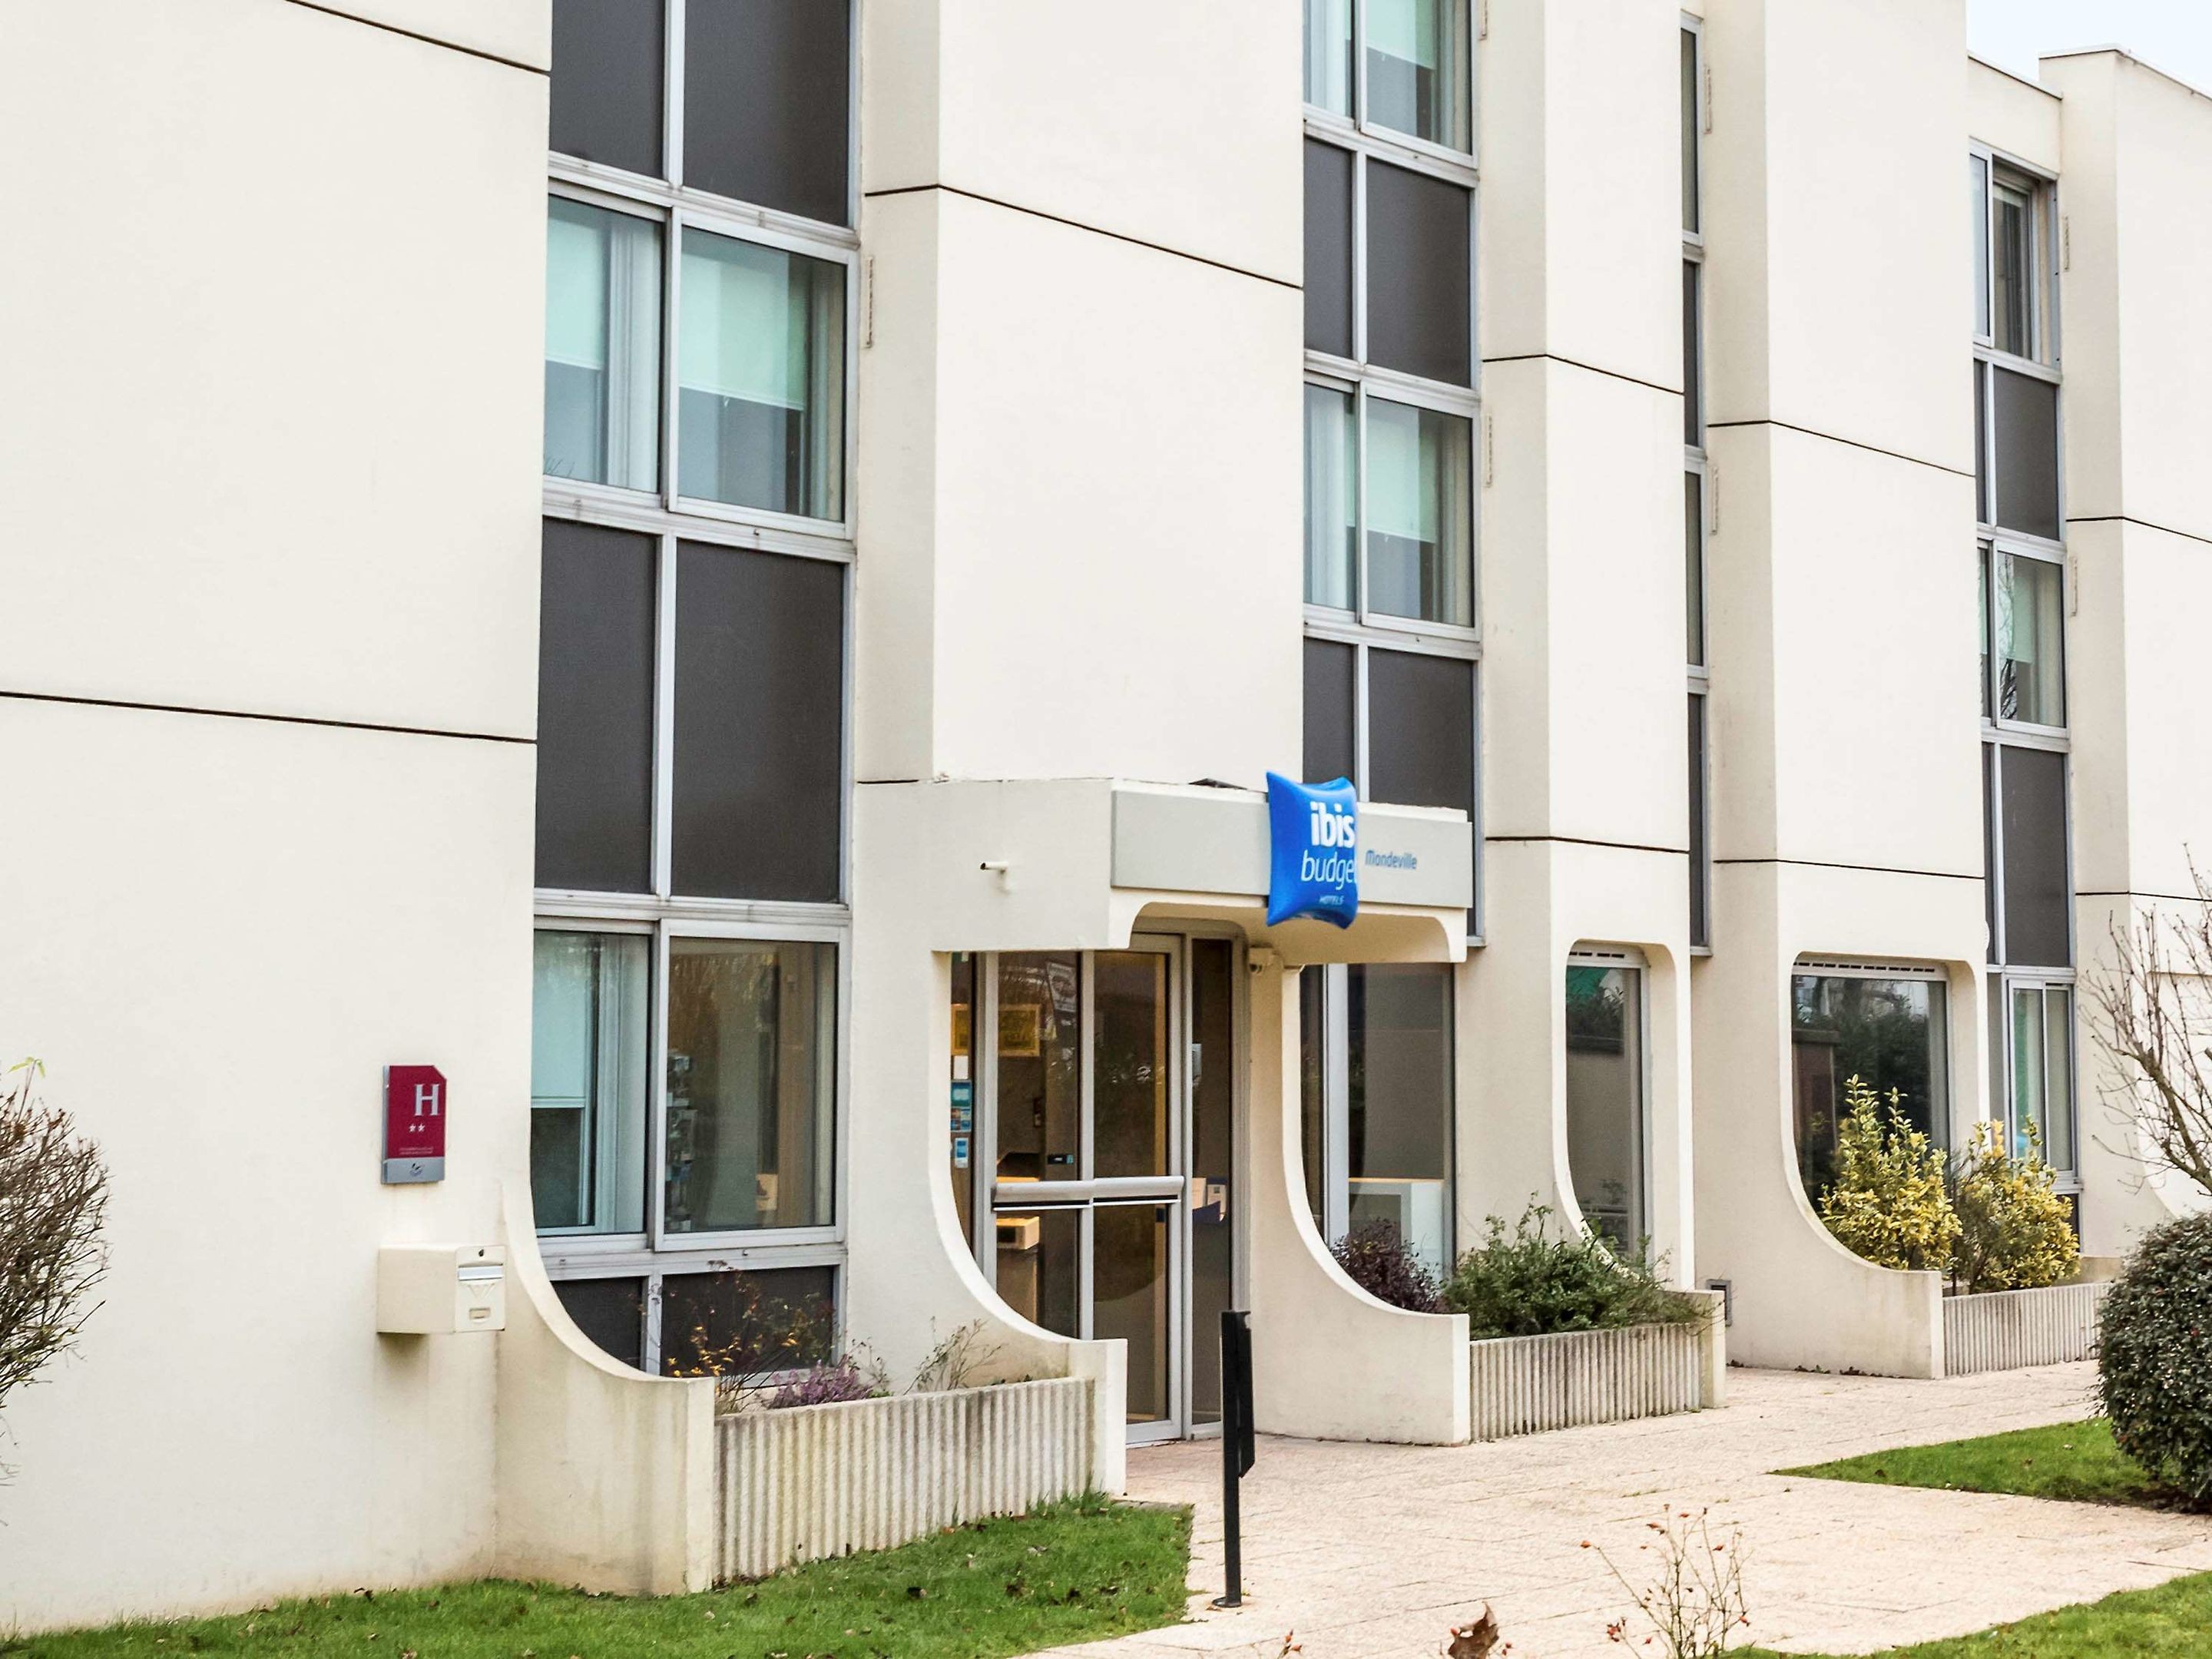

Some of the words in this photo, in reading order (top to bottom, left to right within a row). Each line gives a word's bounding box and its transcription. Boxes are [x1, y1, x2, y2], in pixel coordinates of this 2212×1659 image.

[1310, 800, 1356, 848] ibis
[1365, 849, 1417, 869] Mondeville
[413, 1083, 440, 1117] H
